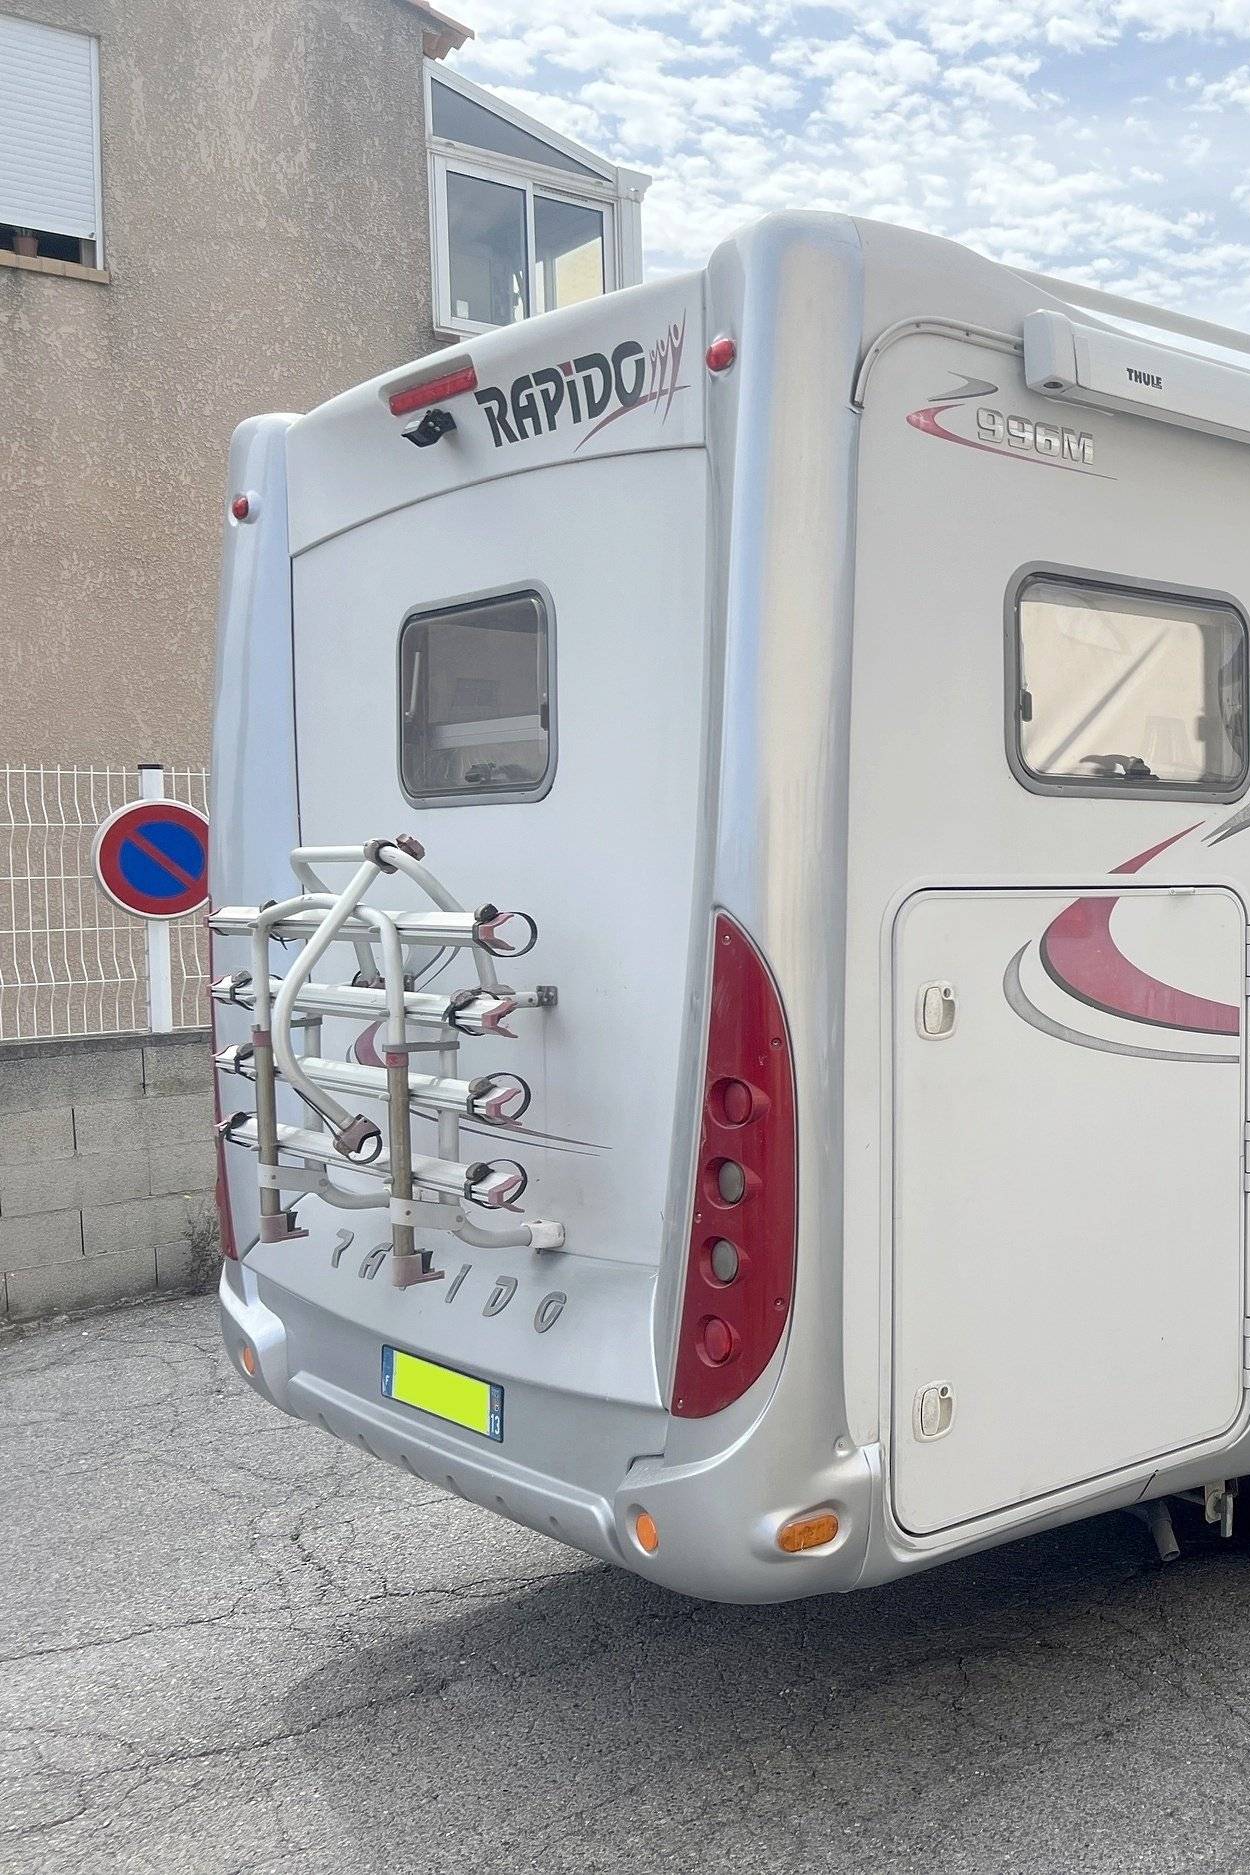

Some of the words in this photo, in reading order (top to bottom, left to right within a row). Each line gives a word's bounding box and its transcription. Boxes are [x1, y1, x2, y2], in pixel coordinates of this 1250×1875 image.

[1126, 367, 1163, 390] THULE
[976, 406, 1095, 466] 996M
[331, 1228, 568, 1334] RAIDO
[490, 1413, 501, 1435] 13
